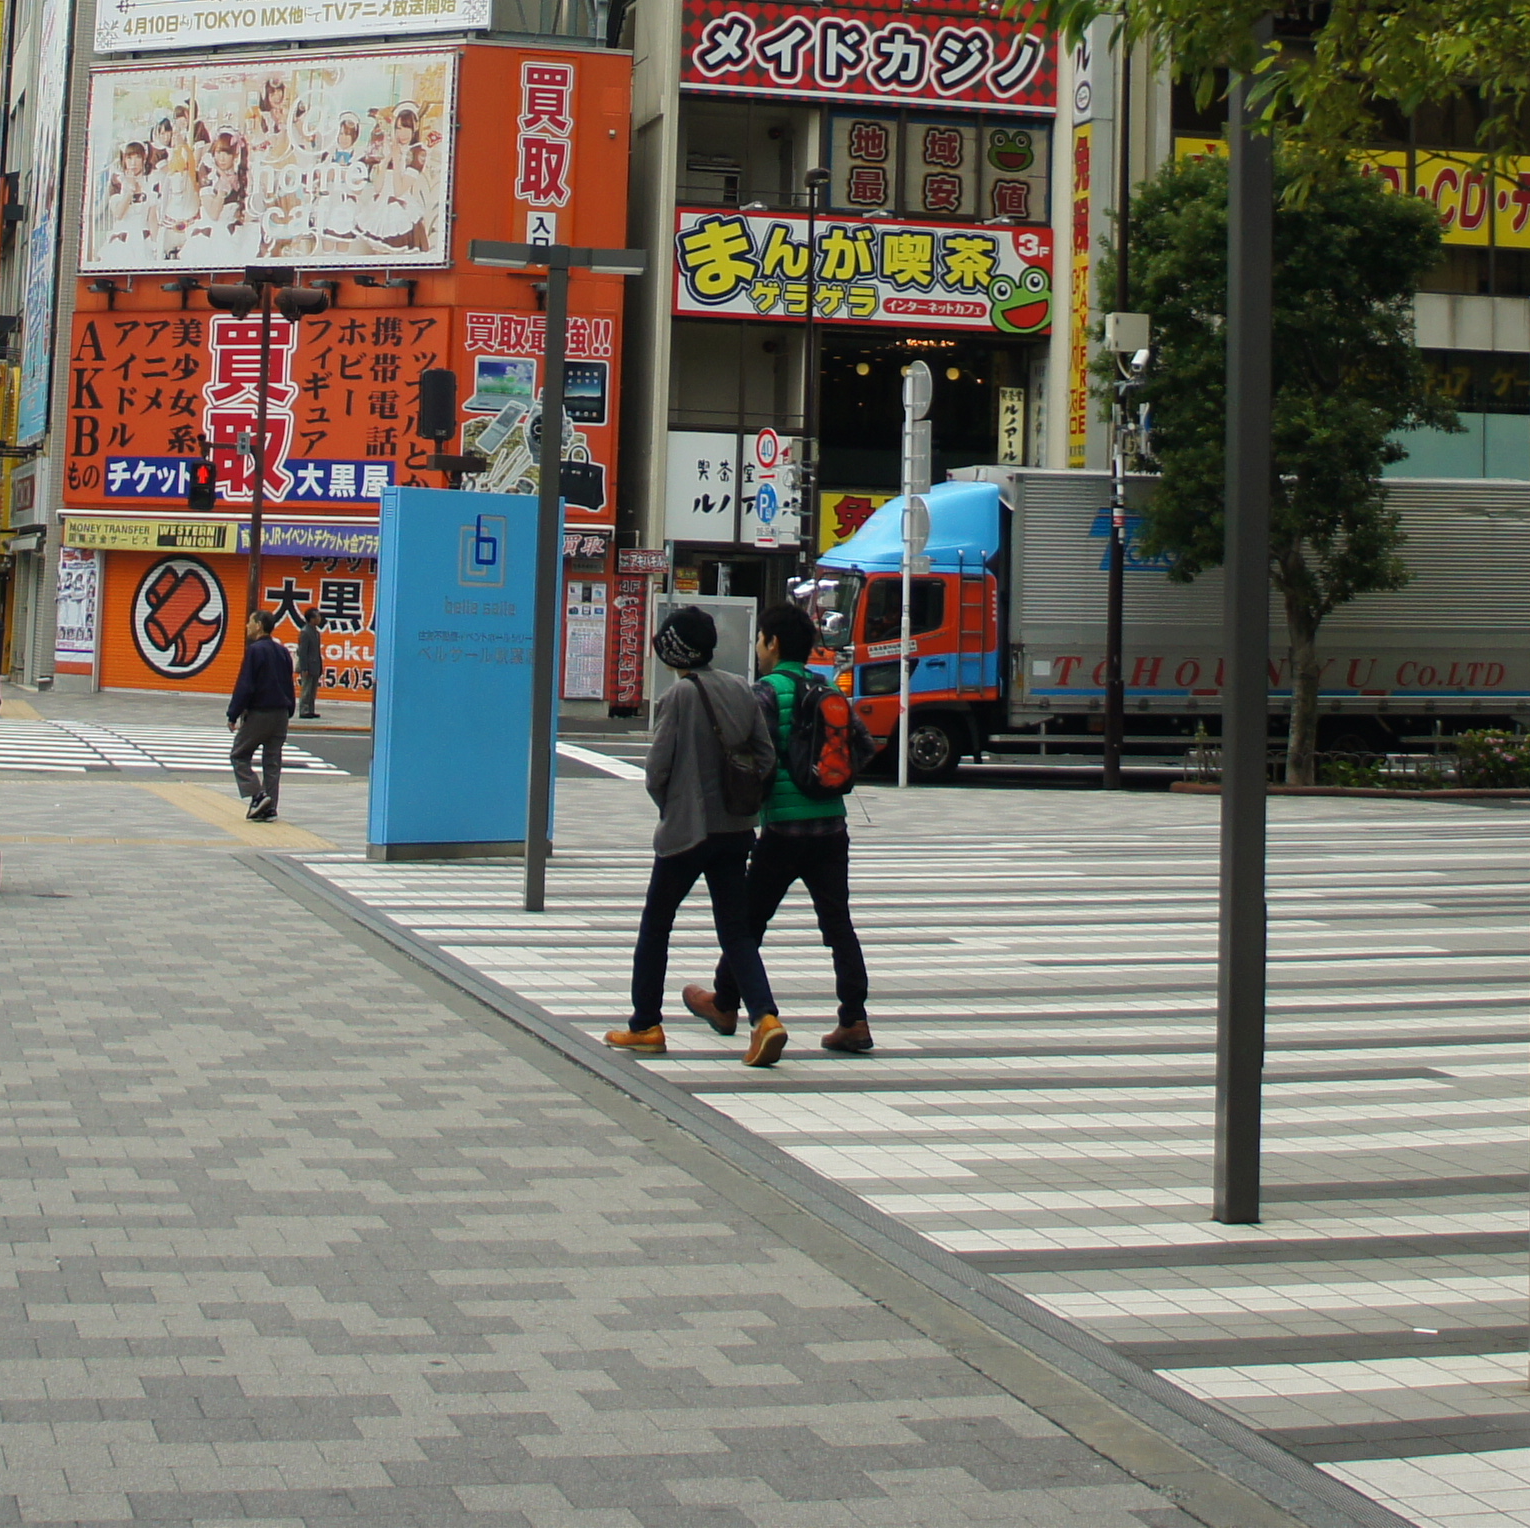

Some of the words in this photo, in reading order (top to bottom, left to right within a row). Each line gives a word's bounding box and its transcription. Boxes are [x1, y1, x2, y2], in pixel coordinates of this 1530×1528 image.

[700, 15, 1046, 95] メイドカジノ
[518, 63, 574, 208] 買取
[851, 122, 962, 165] 地域
[849, 167, 1029, 217] 最安値
[679, 217, 1002, 305] まんが喫茶
[1017, 232, 1051, 258] 3F
[749, 280, 879, 317] ゲラゲラ
[886, 298, 984, 317] インターネットカフェ
[71, 319, 107, 457] AKB
[111, 320, 140, 448] アイドル
[140, 319, 171, 415] アニメ
[167, 318, 204, 454] 美少女系
[300, 319, 333, 457] フィギュア
[337, 318, 367, 417] ホビー
[366, 317, 404, 457] 携帯電話
[1077, 346, 1088, 435] FREE
[206, 318, 296, 500] 買取
[1003, 403, 1019, 462] ルノアール
[66, 461, 100, 491] もの
[697, 458, 757, 484] 喫茶室
[761, 439, 774, 458] 40
[296, 462, 390, 497] 大黒屋
[69, 522, 102, 534] MONEY
[103, 524, 150, 535] TRANSFER
[159, 525, 215, 537] WESTERN
[175, 535, 215, 548] UNION
[563, 534, 605, 557] 買取
[265, 577, 376, 635] 大黒
